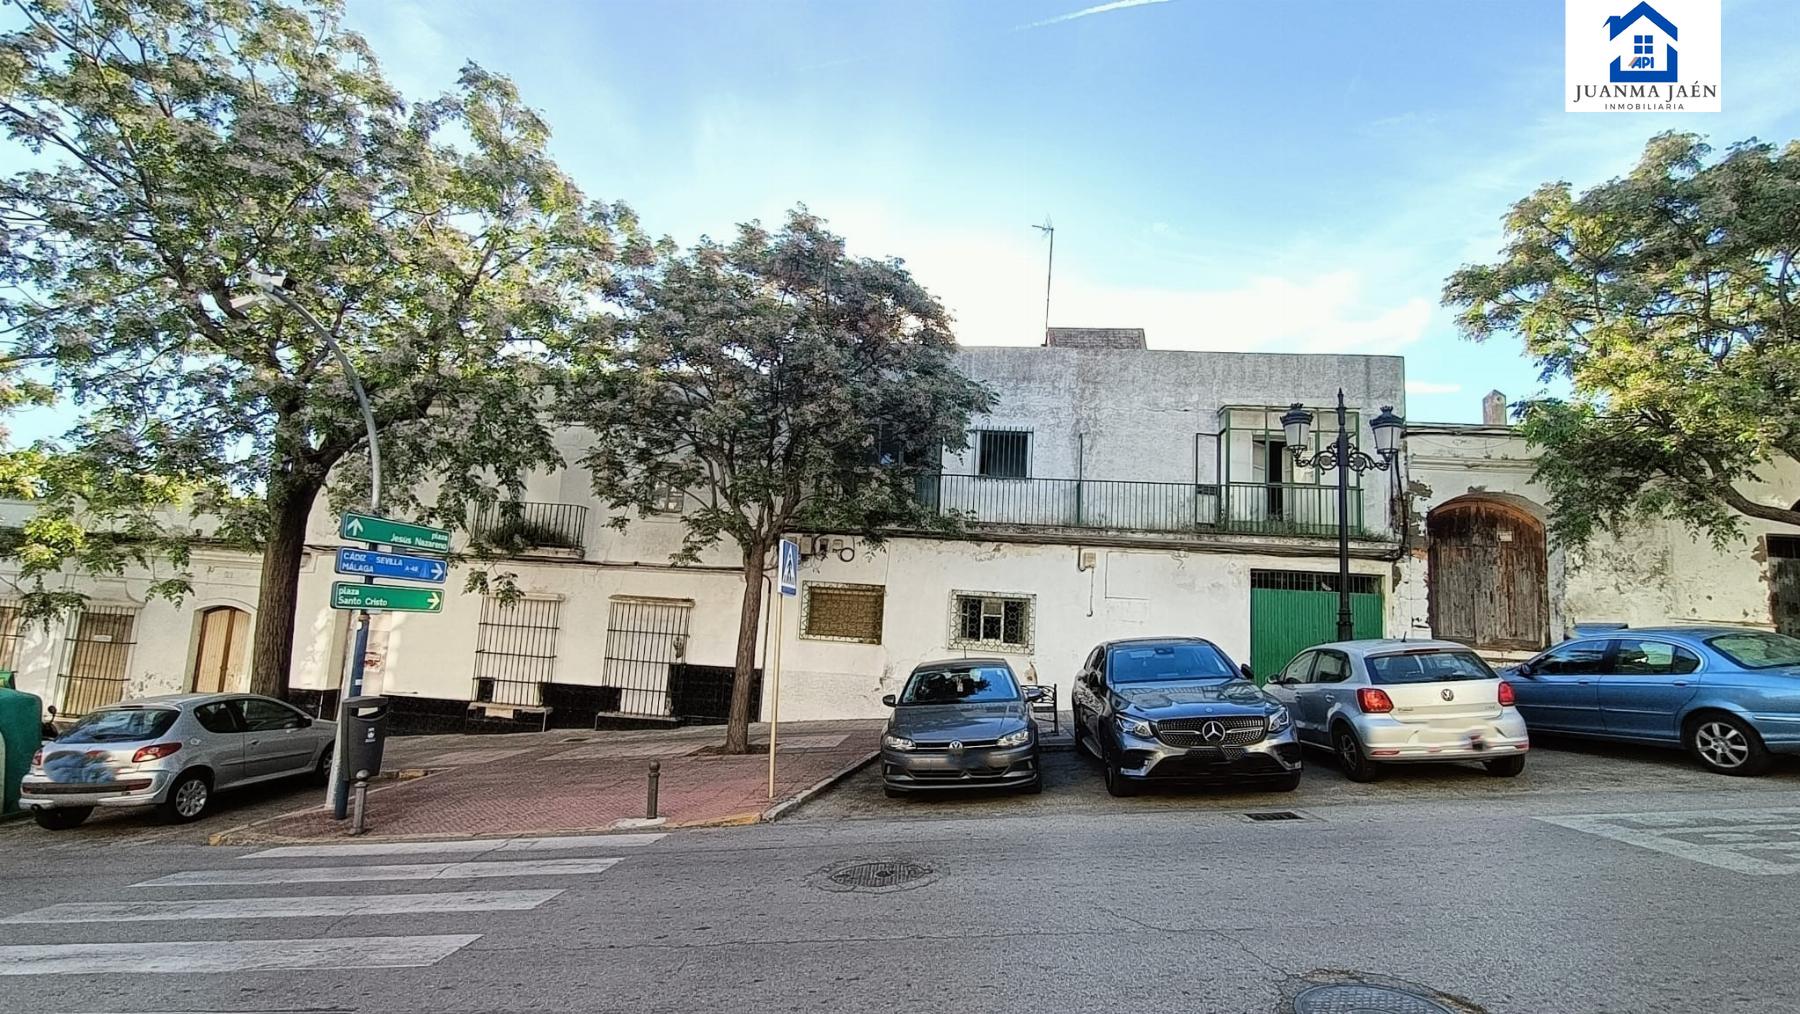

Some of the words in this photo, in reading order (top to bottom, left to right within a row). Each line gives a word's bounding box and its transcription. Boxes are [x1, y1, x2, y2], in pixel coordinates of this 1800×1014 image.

[431, 532, 449, 542] plaza
[414, 538, 448, 550] Nazareno
[343, 551, 367, 561] CÁDIZ
[375, 556, 403, 566] SEVILLA
[341, 561, 374, 573] MÁLAGA
[338, 586, 360, 596] plaza
[338, 597, 362, 605] Santo
[364, 597, 388, 606] Cristo
